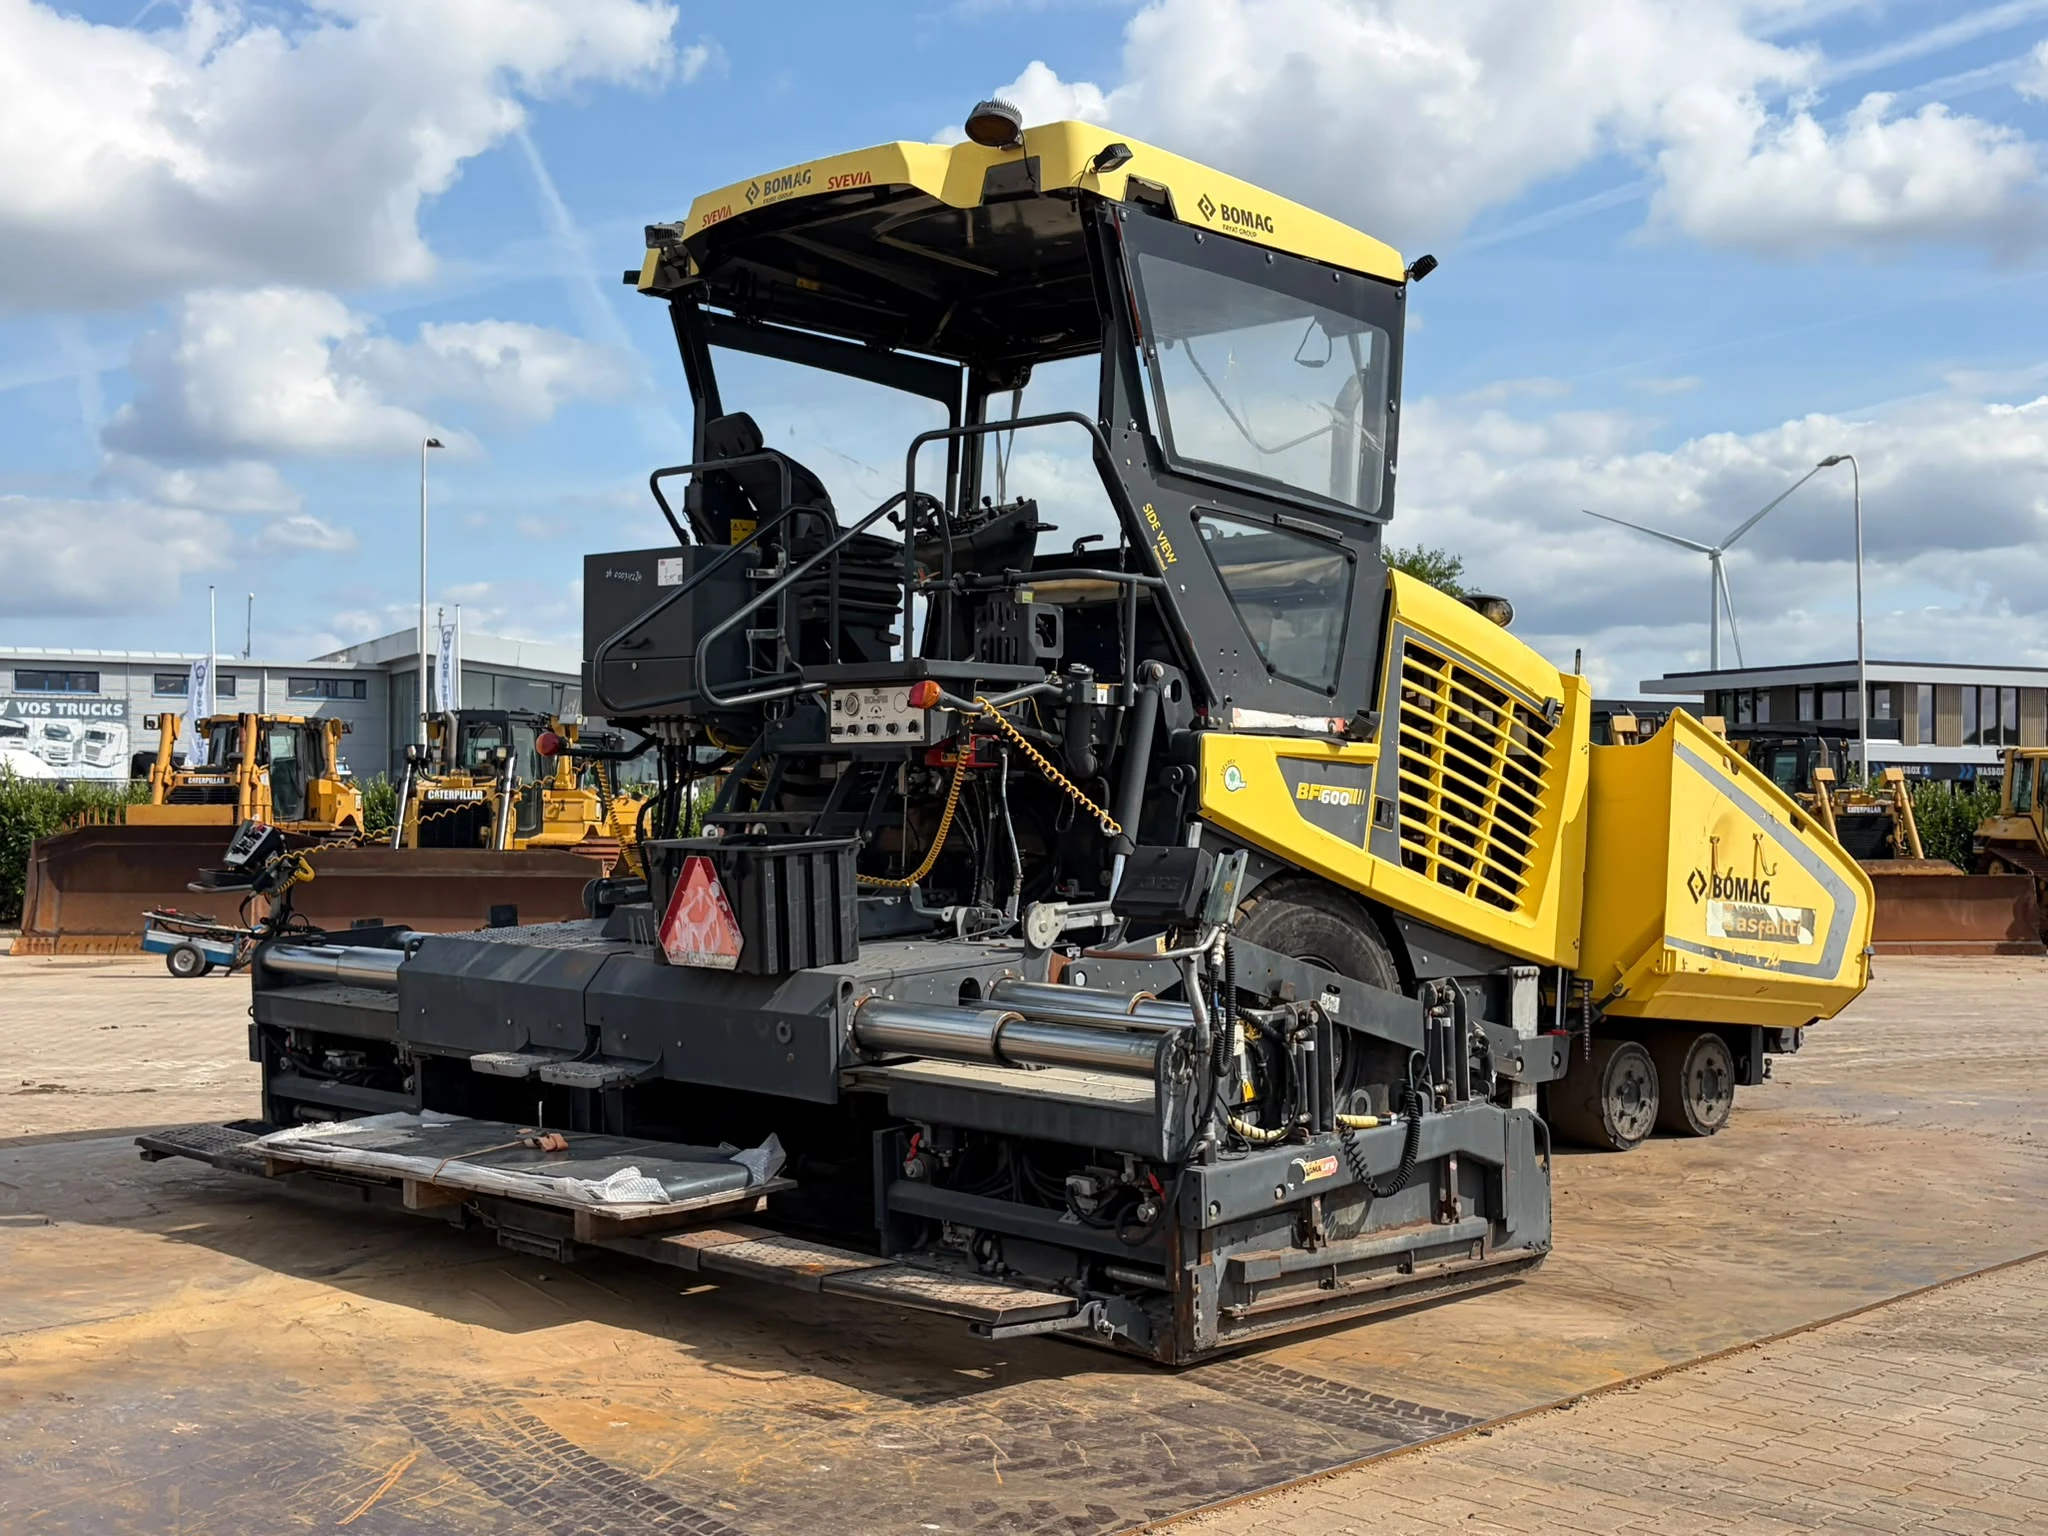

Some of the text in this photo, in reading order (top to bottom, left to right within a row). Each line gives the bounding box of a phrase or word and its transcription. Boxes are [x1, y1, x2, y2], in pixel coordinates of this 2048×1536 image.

[764, 169, 812, 197] BOMAG
[828, 171, 872, 190] SVEVIA
[702, 205, 732, 228] SVEVIA
[1220, 203, 1274, 234] BOMAG
[1142, 503, 1161, 531] SIDE
[1156, 530, 1177, 563] VIEW
[16, 701, 124, 716] VOS TRUCKS
[428, 789, 484, 800] CATERPILLAR
[1712, 873, 1770, 904] BOMAG
